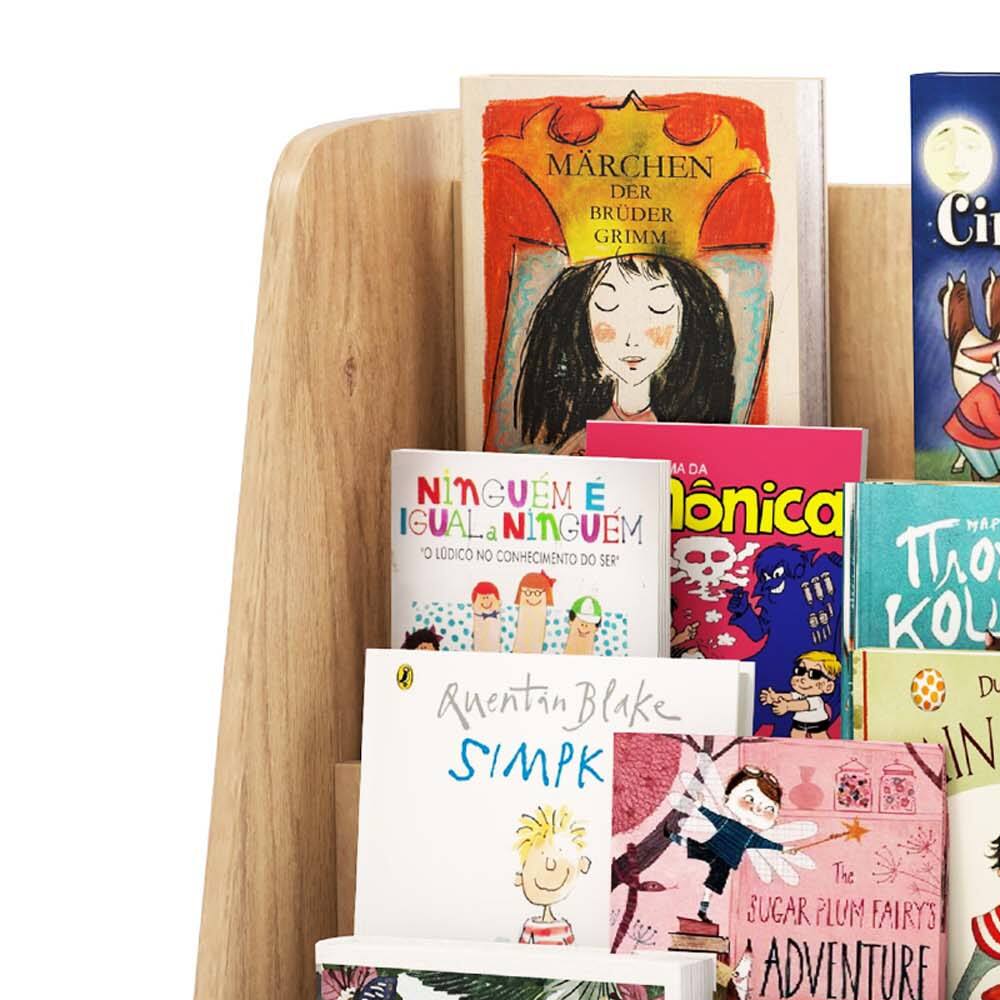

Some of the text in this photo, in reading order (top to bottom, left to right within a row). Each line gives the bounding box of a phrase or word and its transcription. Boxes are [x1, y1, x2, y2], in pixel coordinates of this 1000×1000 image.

[545, 149, 714, 180] MÄRCHEN
[609, 183, 652, 200] DER
[589, 203, 674, 223] BRÜDER
[593, 228, 668, 245] GRIMM
[688, 463, 708, 475] DA
[585, 476, 606, 512] É
[671, 477, 844, 537] ônica
[400, 507, 484, 539] IGUAL
[486, 525, 498, 541] a
[435, 547, 474, 561] LÚDICO
[476, 549, 494, 562] NO
[496, 549, 578, 565] CONHECIMENTO
[580, 553, 597, 566] DO
[437, 672, 680, 732] Quentin Blake
[448, 738, 605, 788] SIMPK
[934, 716, 996, 783] IN
[832, 860, 855, 885] The
[747, 893, 937, 931] SUGAR PLUM FAIRY'S
